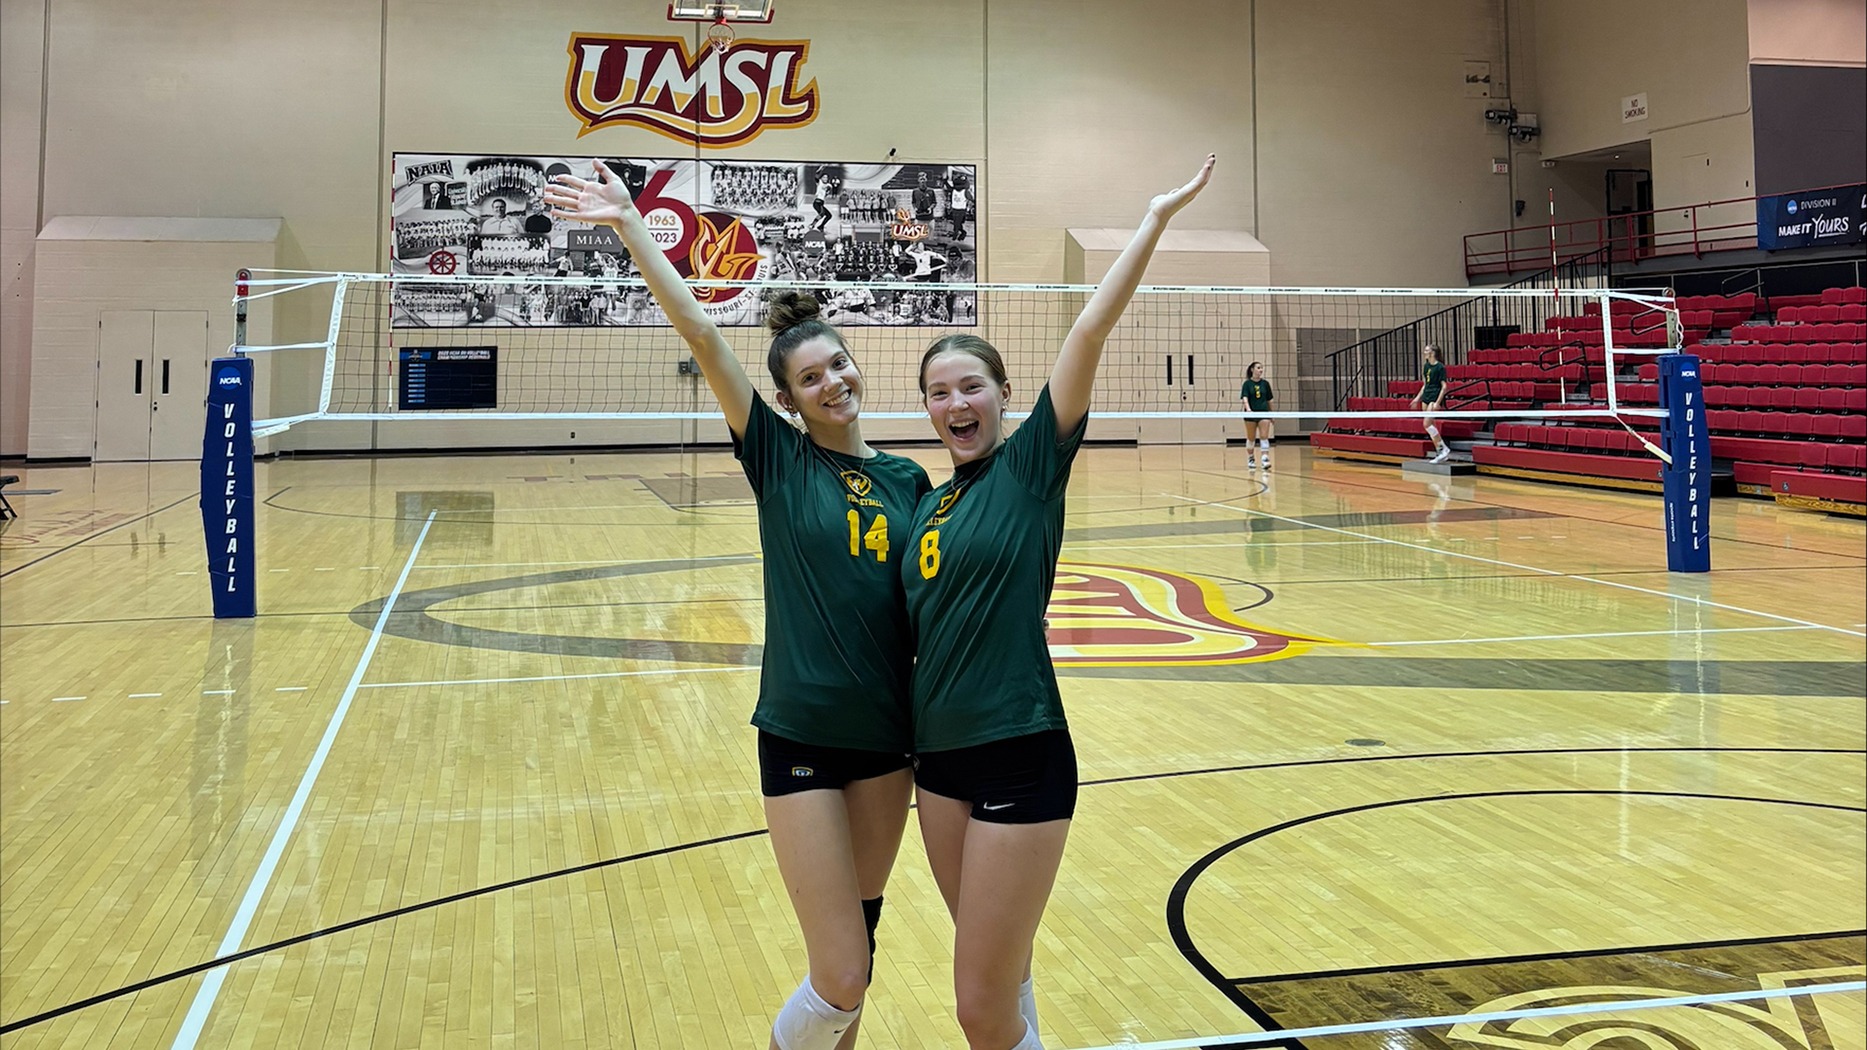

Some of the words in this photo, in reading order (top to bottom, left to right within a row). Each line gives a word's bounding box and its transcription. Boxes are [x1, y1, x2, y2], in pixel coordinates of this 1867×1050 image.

[577, 44, 809, 137] UMSL
[1631, 98, 1638, 108] NO
[1624, 106, 1646, 119] SMOKING
[406, 160, 452, 184] NAIA
[1800, 199, 1831, 210] DIVISION
[649, 215, 676, 226] 1963
[893, 224, 928, 240] UMSL
[1778, 224, 1801, 237] MAKE
[1801, 223, 1812, 234] IT
[576, 235, 613, 245] MIAA
[804, 240, 826, 250] NCAA
[219, 377, 242, 386] NCAA
[1685, 392, 1699, 550] VOLLEYBALL
[223, 403, 237, 592] VOLLEYBALL
[847, 508, 890, 563] 14
[919, 529, 941, 580] 8
